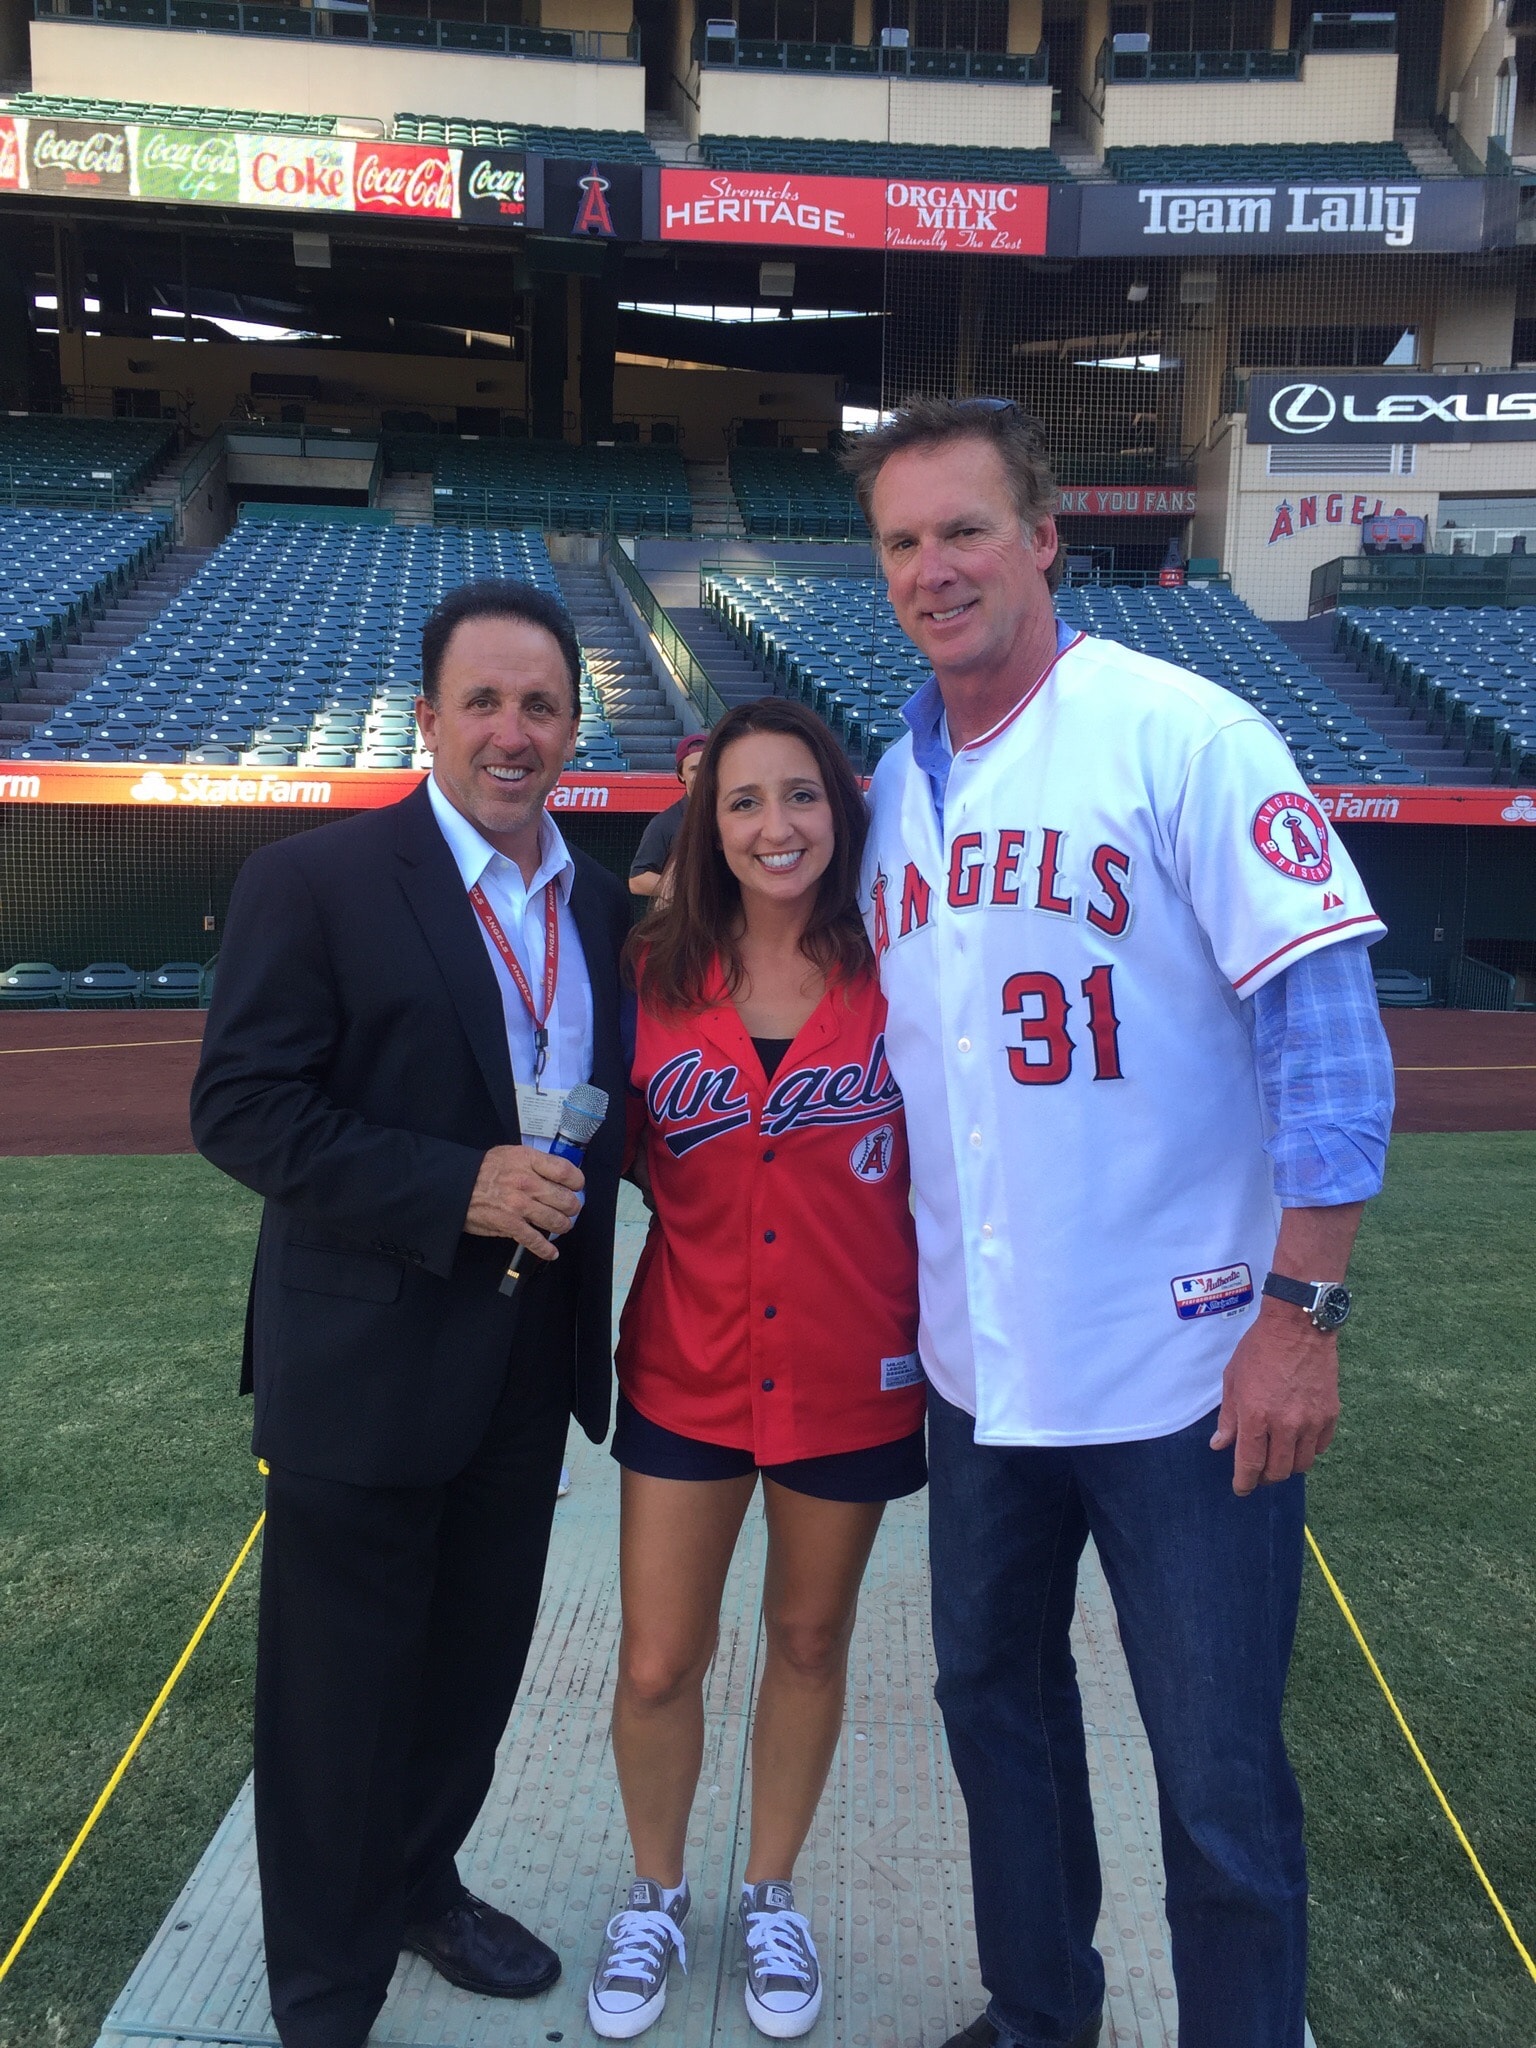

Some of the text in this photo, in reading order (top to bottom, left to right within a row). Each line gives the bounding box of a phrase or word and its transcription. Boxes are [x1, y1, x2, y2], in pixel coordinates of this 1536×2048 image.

[253, 152, 344, 198] Coke
[702, 176, 800, 201] Stremicks
[500, 202, 524, 214] zer
[885, 183, 1018, 212] ORGANIC
[666, 198, 845, 236] HERITAGE
[916, 208, 998, 231] MILK
[1138, 186, 1421, 246] Team Lally
[884, 226, 1022, 251] Naturally The Best
[1343, 392, 1536, 422] LEXUS
[1096, 491, 1140, 512] YOU
[1143, 491, 1197, 512] FANS
[1258, 794, 1310, 824] ANGELS
[870, 828, 1131, 976] ANGELS
[486, 915, 509, 954] ANGELS
[511, 963, 532, 1003] ANGELS
[1002, 964, 1125, 1086] 31
